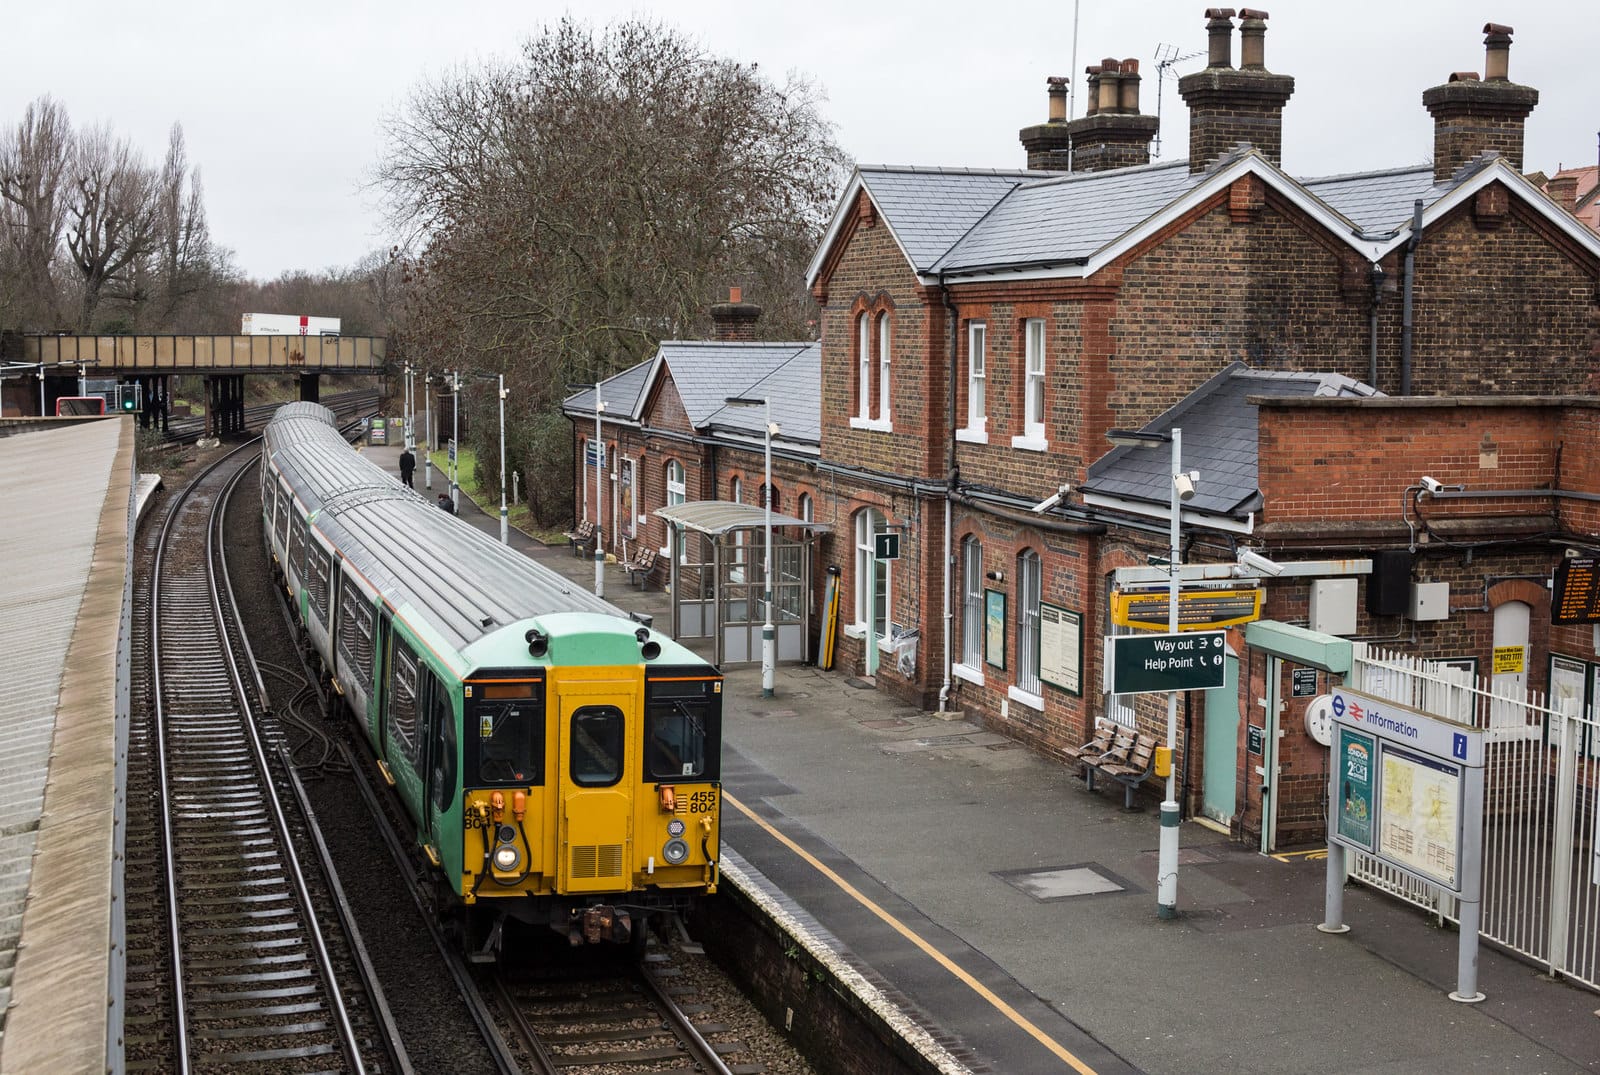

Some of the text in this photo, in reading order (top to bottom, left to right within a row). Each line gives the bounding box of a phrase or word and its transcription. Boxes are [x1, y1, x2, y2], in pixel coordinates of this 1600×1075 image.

[884, 537, 890, 556] 1
[1154, 639, 1194, 653] Way out
[1145, 656, 1193, 672] Help Point
[1366, 709, 1418, 739] Information
[1347, 747, 1368, 760] LONDON
[690, 791, 716, 802] 455
[690, 802, 716, 813] 804
